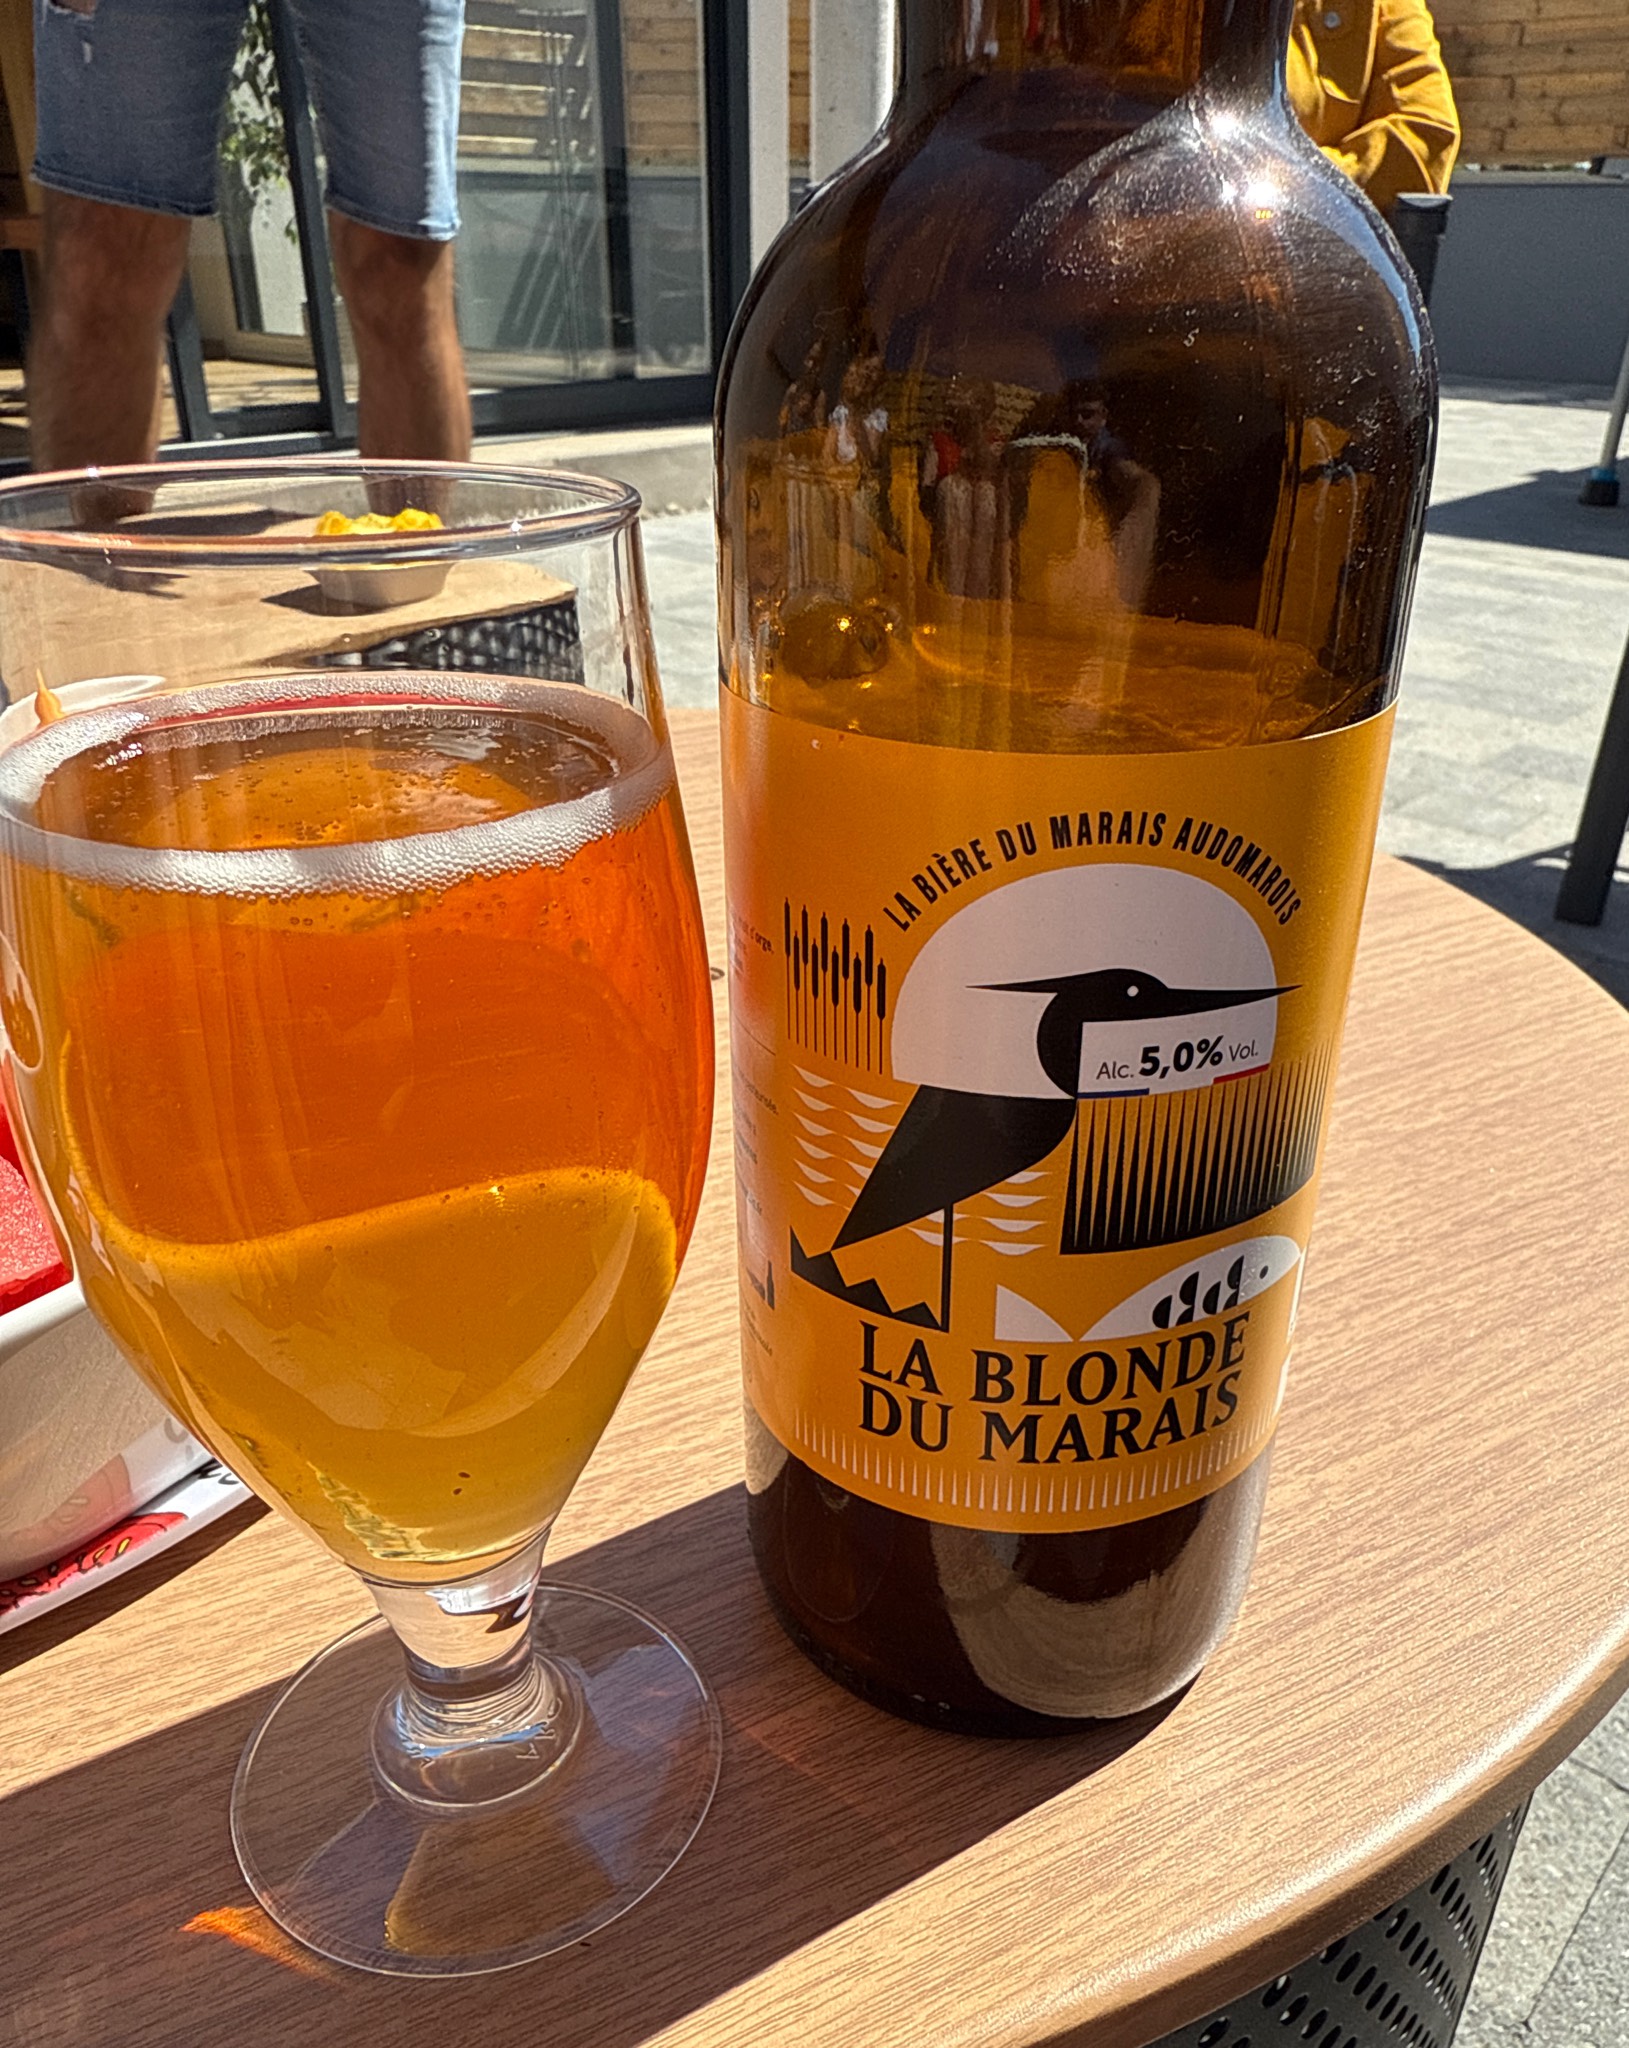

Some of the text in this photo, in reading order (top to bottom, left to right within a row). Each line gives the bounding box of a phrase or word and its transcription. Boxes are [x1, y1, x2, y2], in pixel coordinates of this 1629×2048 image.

[883, 811, 1301, 932] LA BIÈRE DU MARAIS AUDOMAROIS
[1096, 1035, 1259, 1080] Alc. 5,0% Vol.
[859, 1320, 943, 1396] LA
[969, 1311, 1251, 1407] BLONDE
[858, 1370, 1243, 1465] DU MARAIS
